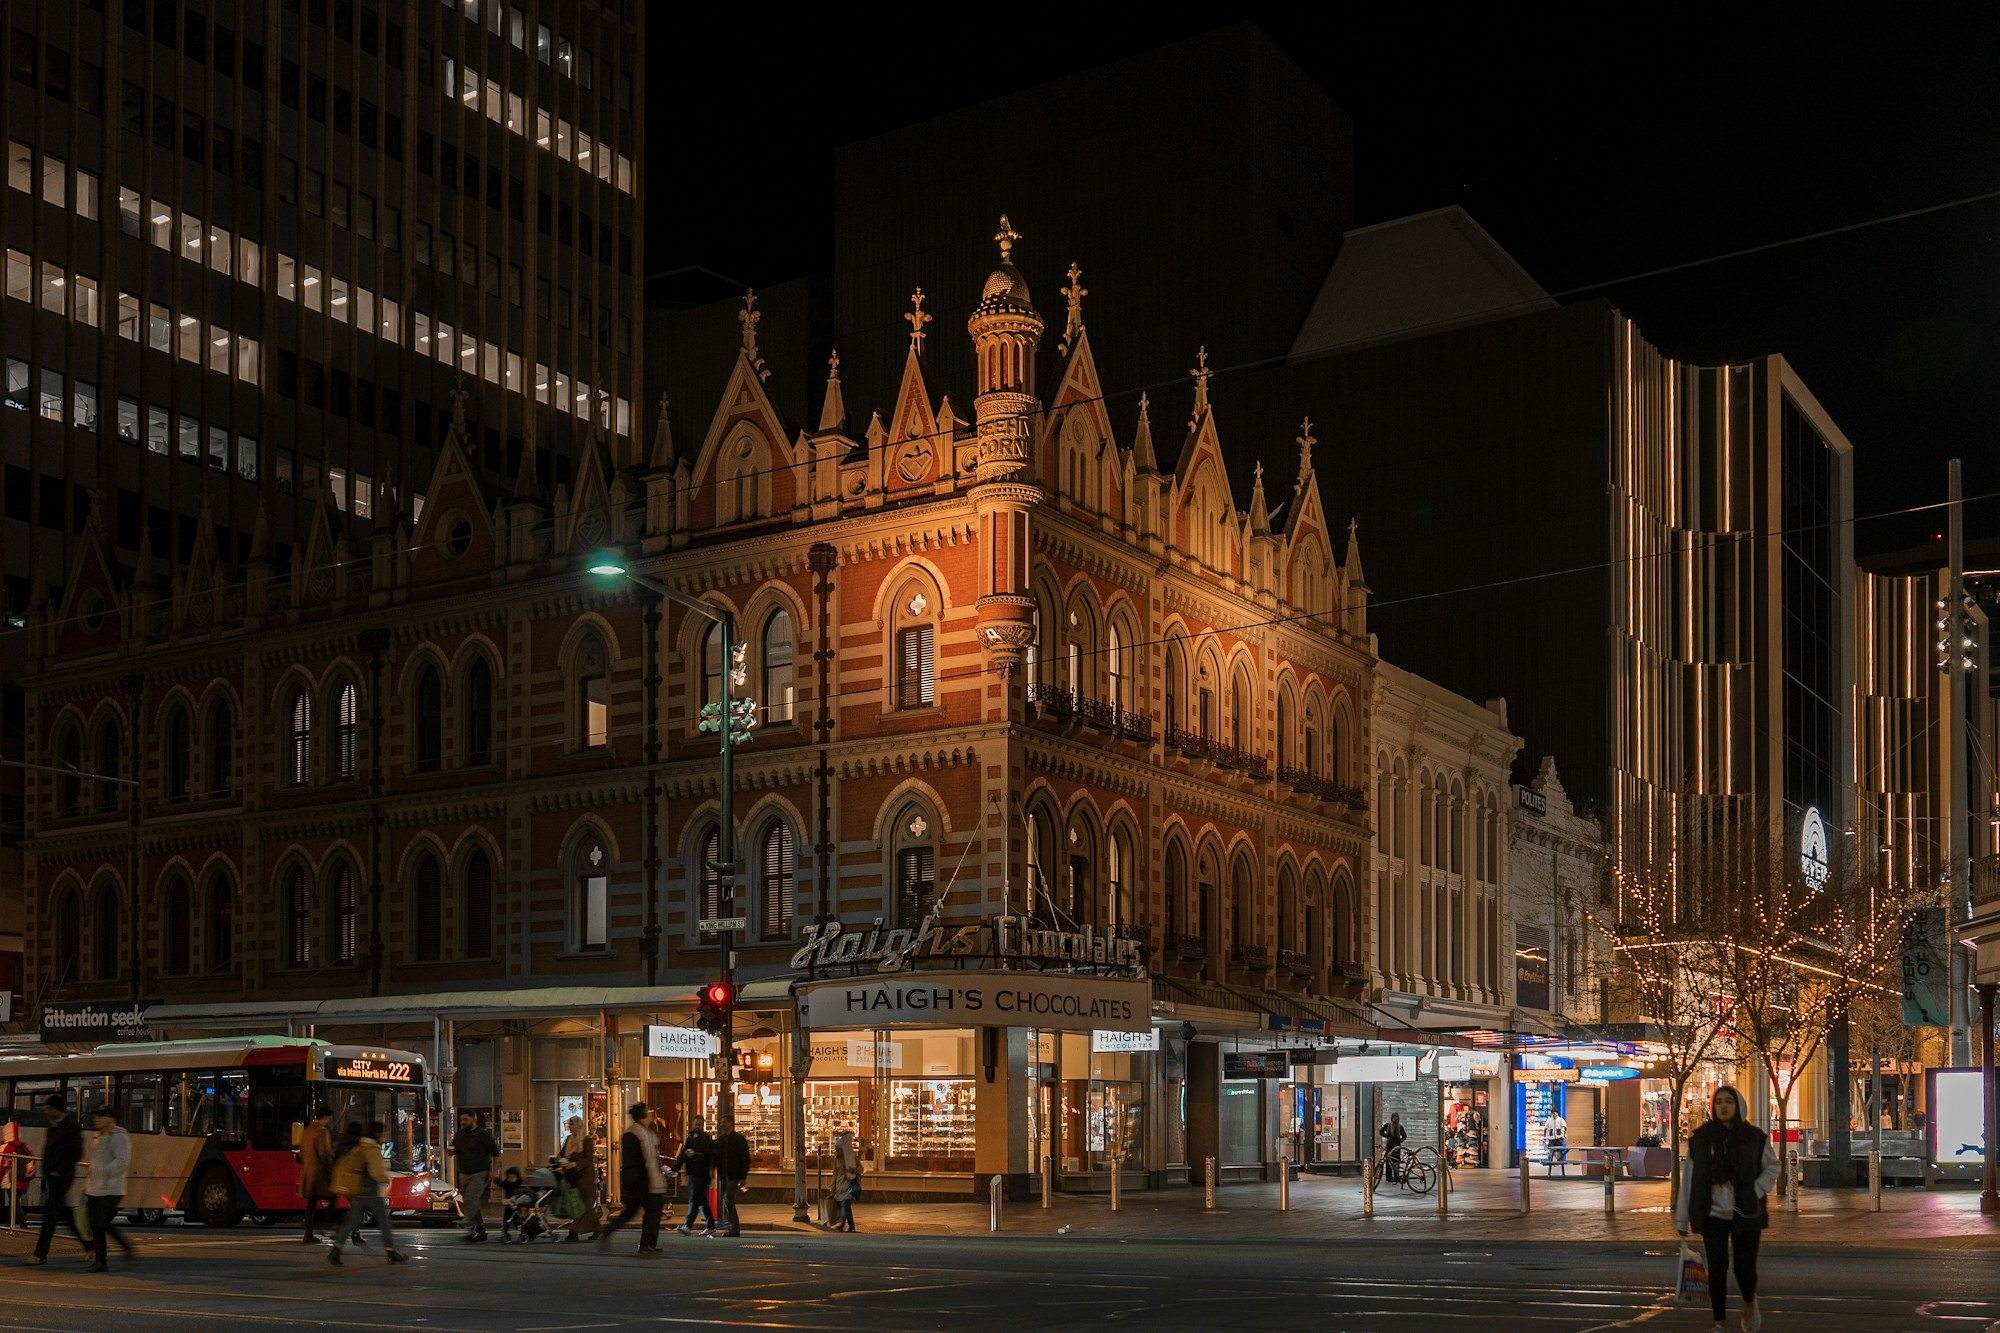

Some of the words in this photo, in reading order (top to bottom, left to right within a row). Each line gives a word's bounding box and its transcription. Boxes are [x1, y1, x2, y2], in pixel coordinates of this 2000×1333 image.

[1521, 790, 1545, 811] POLITES
[1917, 952, 1930, 975] OF
[1903, 956, 1915, 1000] STEP
[846, 988, 982, 1011] HAIGH'S
[995, 990, 1132, 1020] CHOCOLATES
[44, 1006, 108, 1027] attention
[111, 1003, 144, 1026] seek
[660, 1032, 706, 1046] HAIGH'S
[1100, 1032, 1153, 1042] HAIGH'S
[337, 1066, 347, 1076] via
[347, 1067, 361, 1078] Main
[361, 1068, 379, 1079] North
[380, 1069, 388, 1079] Rd
[352, 1060, 371, 1070] CITY
[388, 1062, 410, 1081] 222
